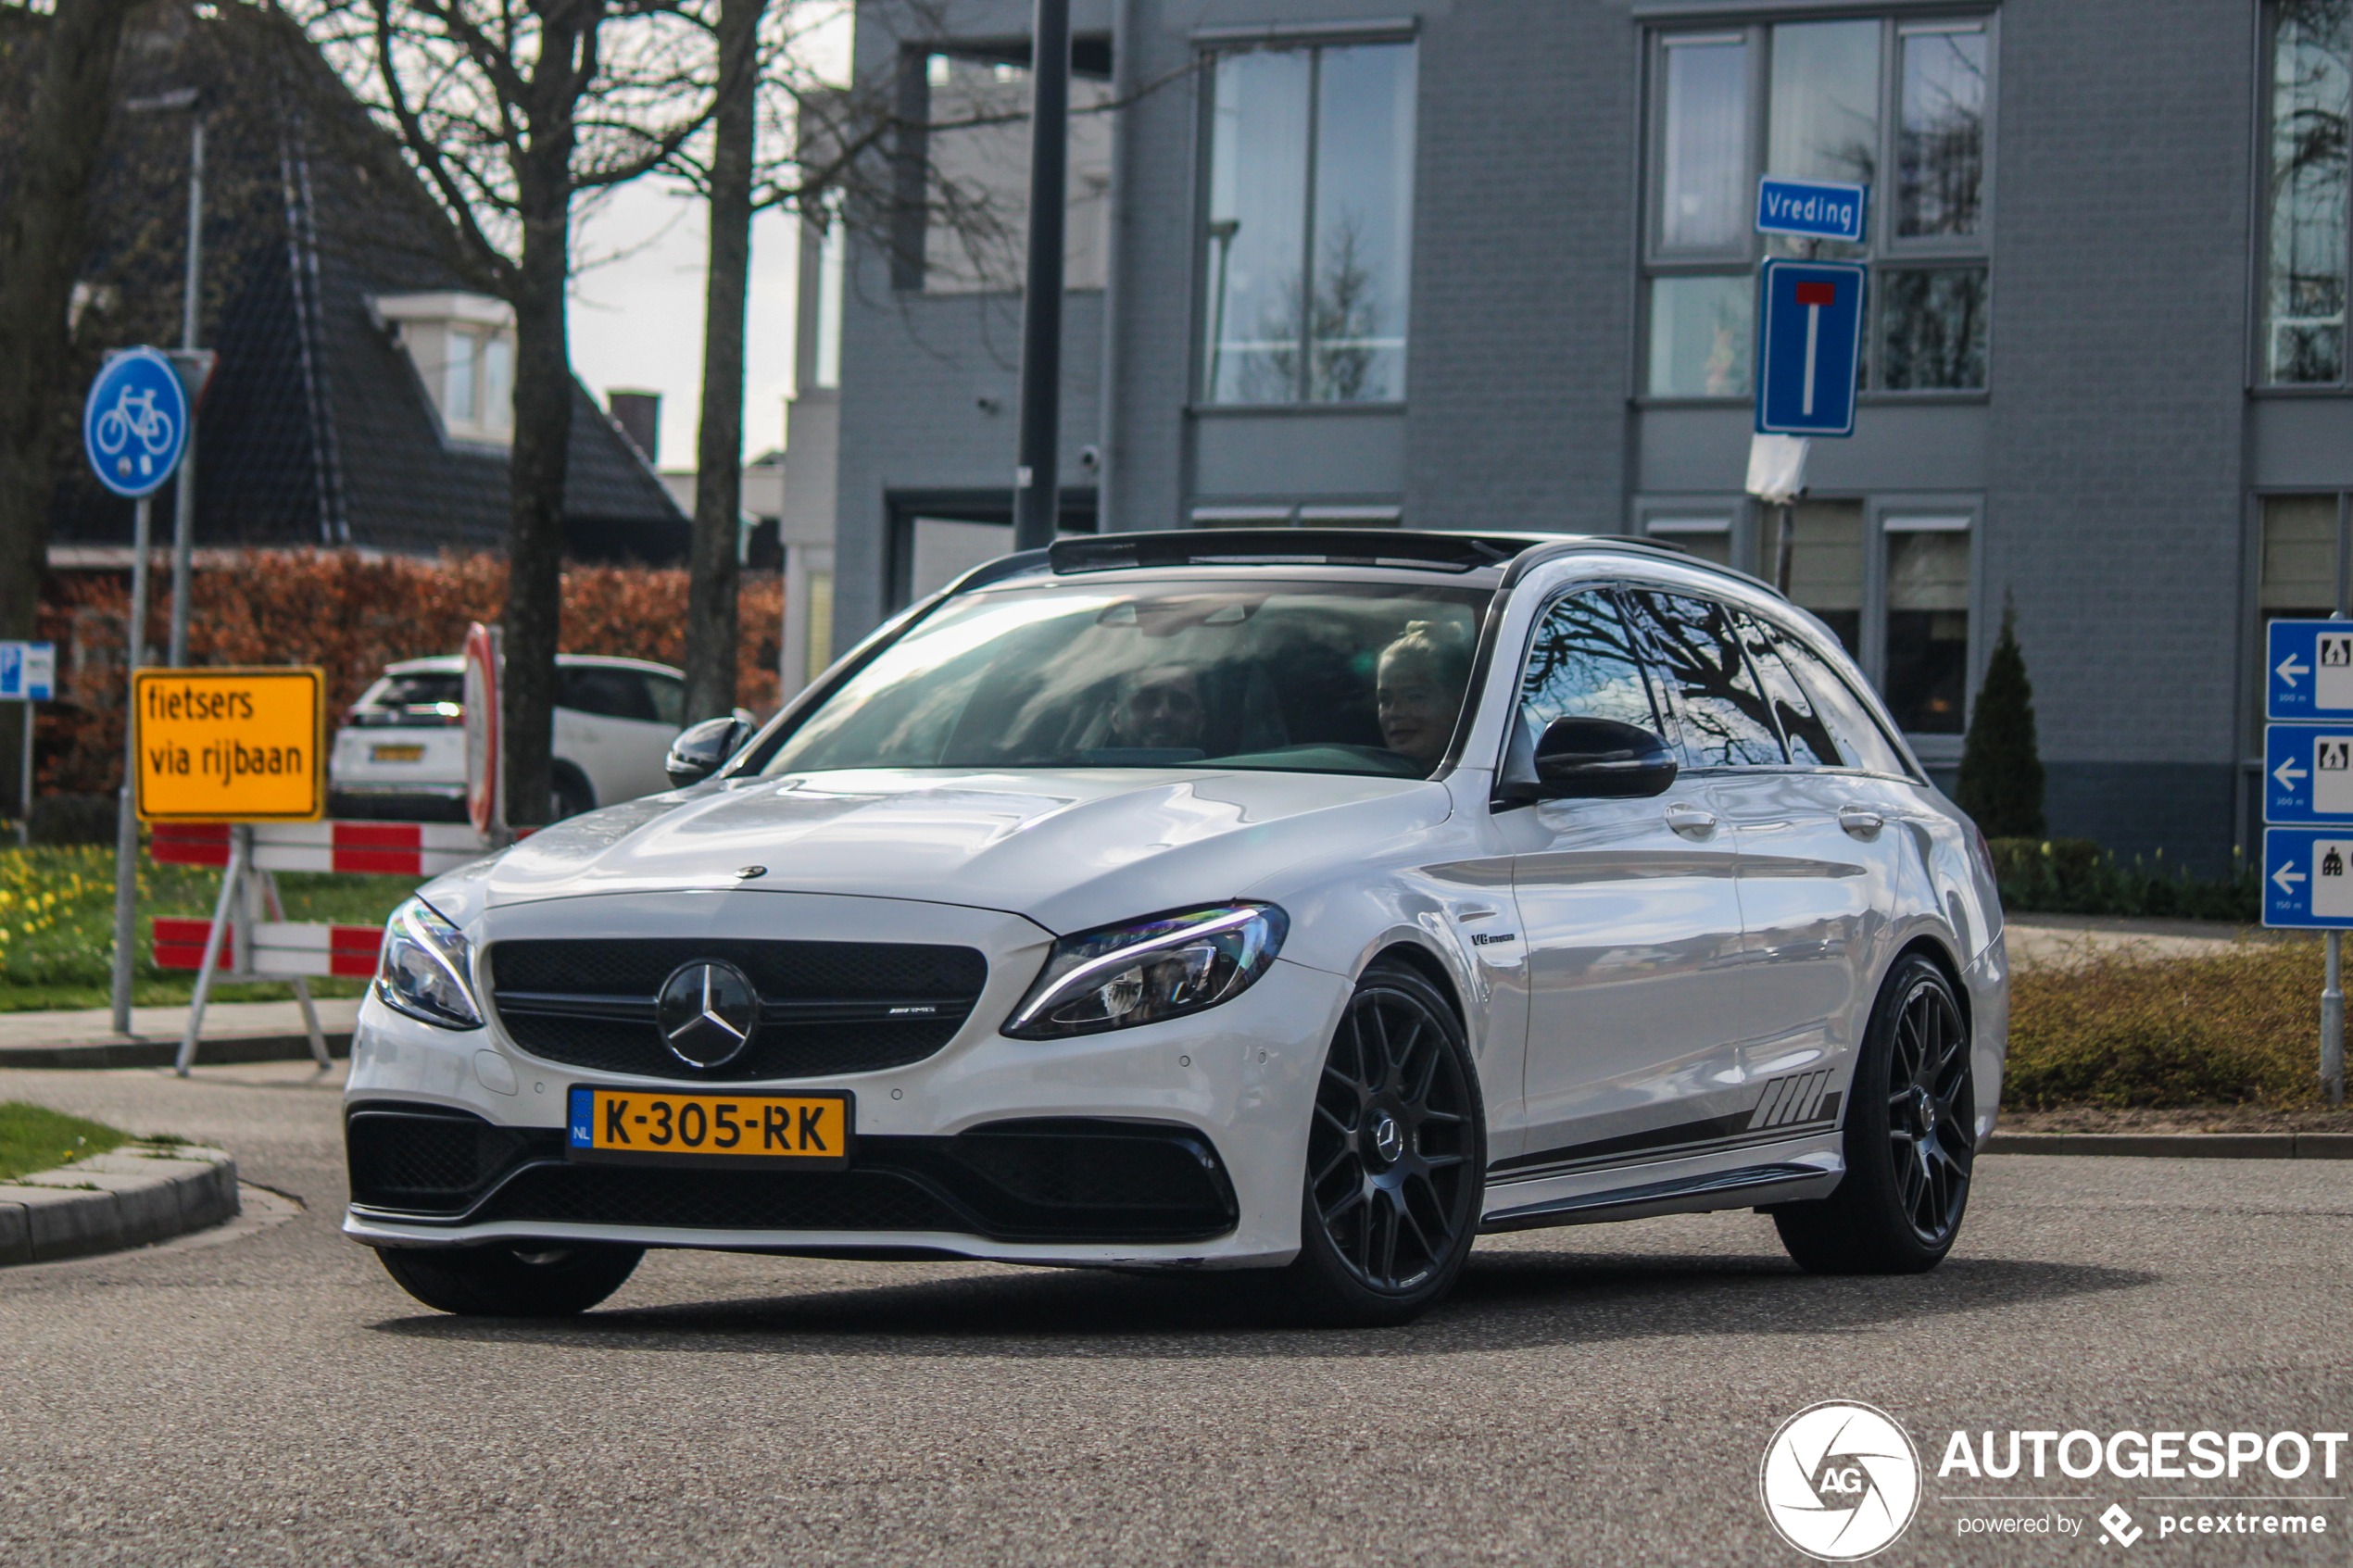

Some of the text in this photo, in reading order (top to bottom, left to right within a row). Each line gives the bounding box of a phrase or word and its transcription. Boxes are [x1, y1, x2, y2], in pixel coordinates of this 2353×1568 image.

[1768, 192, 1852, 232] Vreding
[149, 685, 254, 720] fietsers
[149, 740, 302, 787] via rijbaan
[573, 1126, 591, 1141] NL
[606, 1099, 828, 1151] K-305-RK
